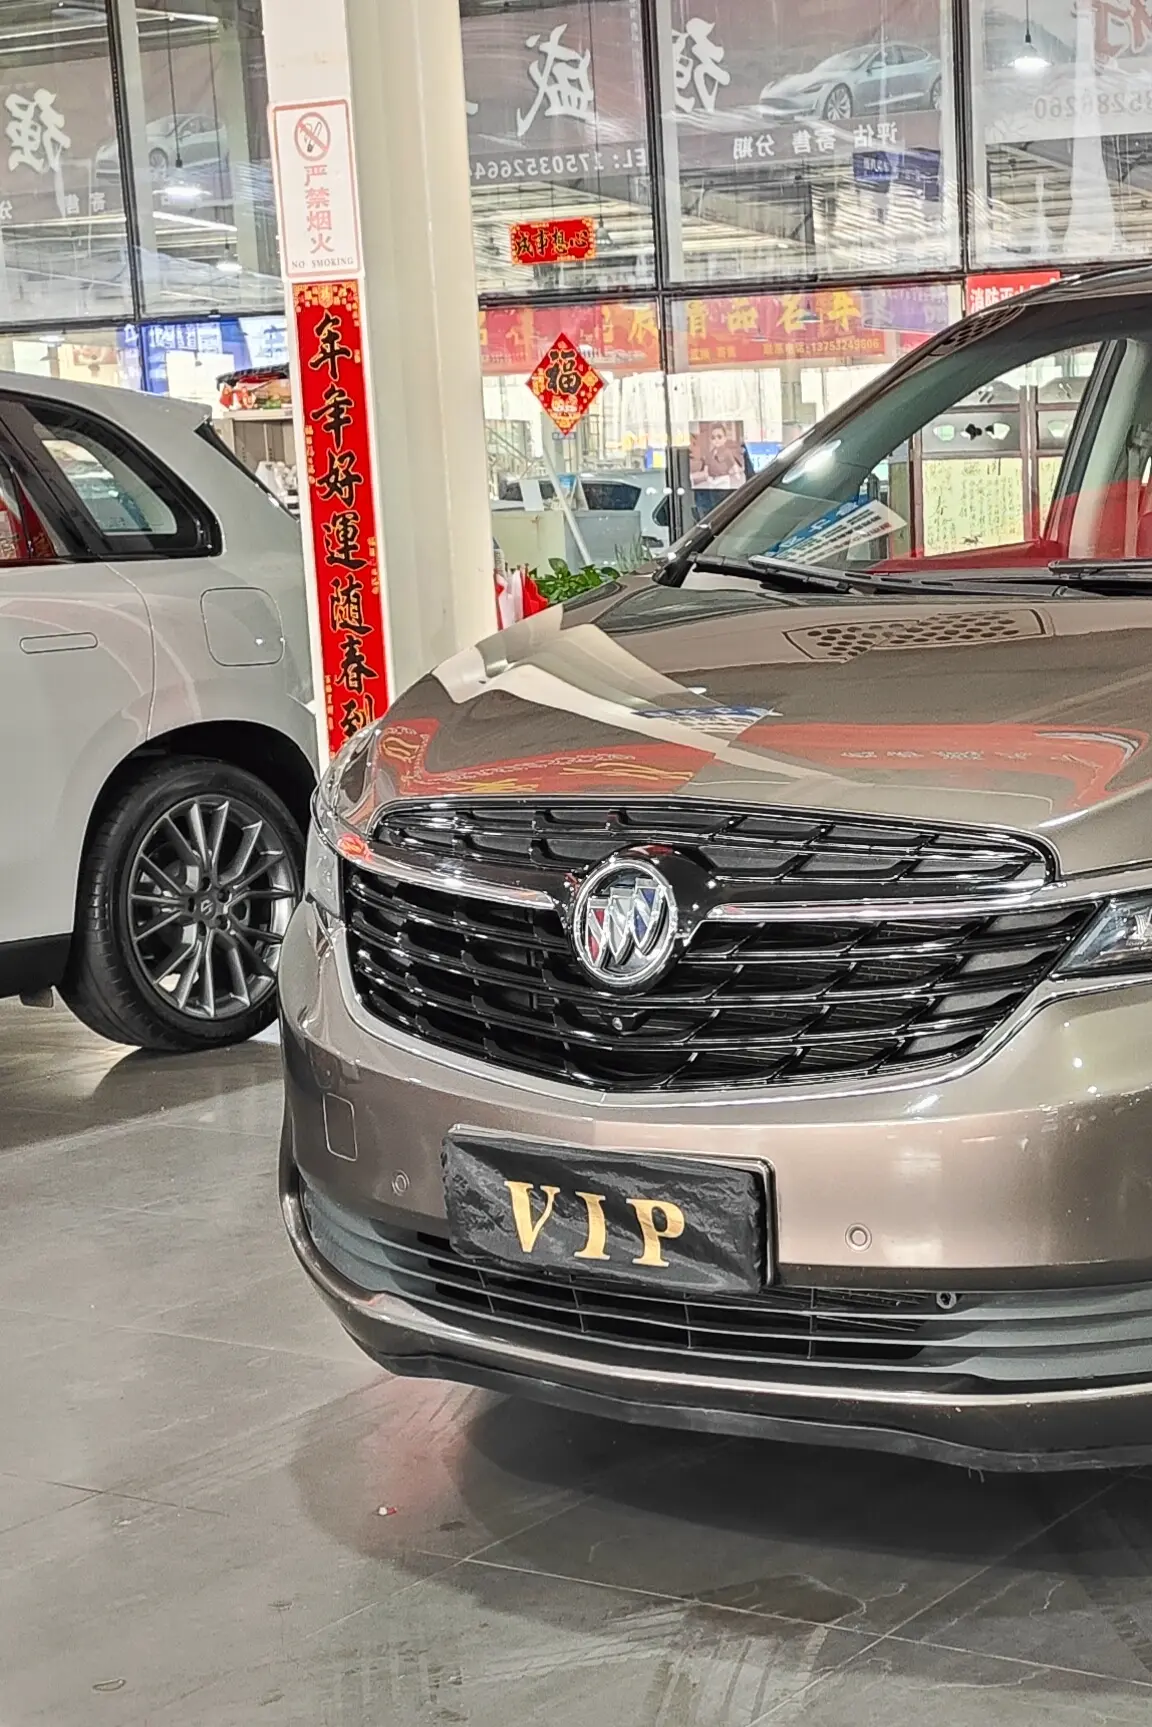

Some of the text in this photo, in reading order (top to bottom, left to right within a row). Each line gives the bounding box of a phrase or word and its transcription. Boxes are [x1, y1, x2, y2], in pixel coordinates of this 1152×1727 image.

[303, 164, 335, 255] 严禁烟火
[291, 257, 354, 269] NO SMOKING
[545, 349, 583, 395] 福
[503, 1179, 686, 1268] VIP
